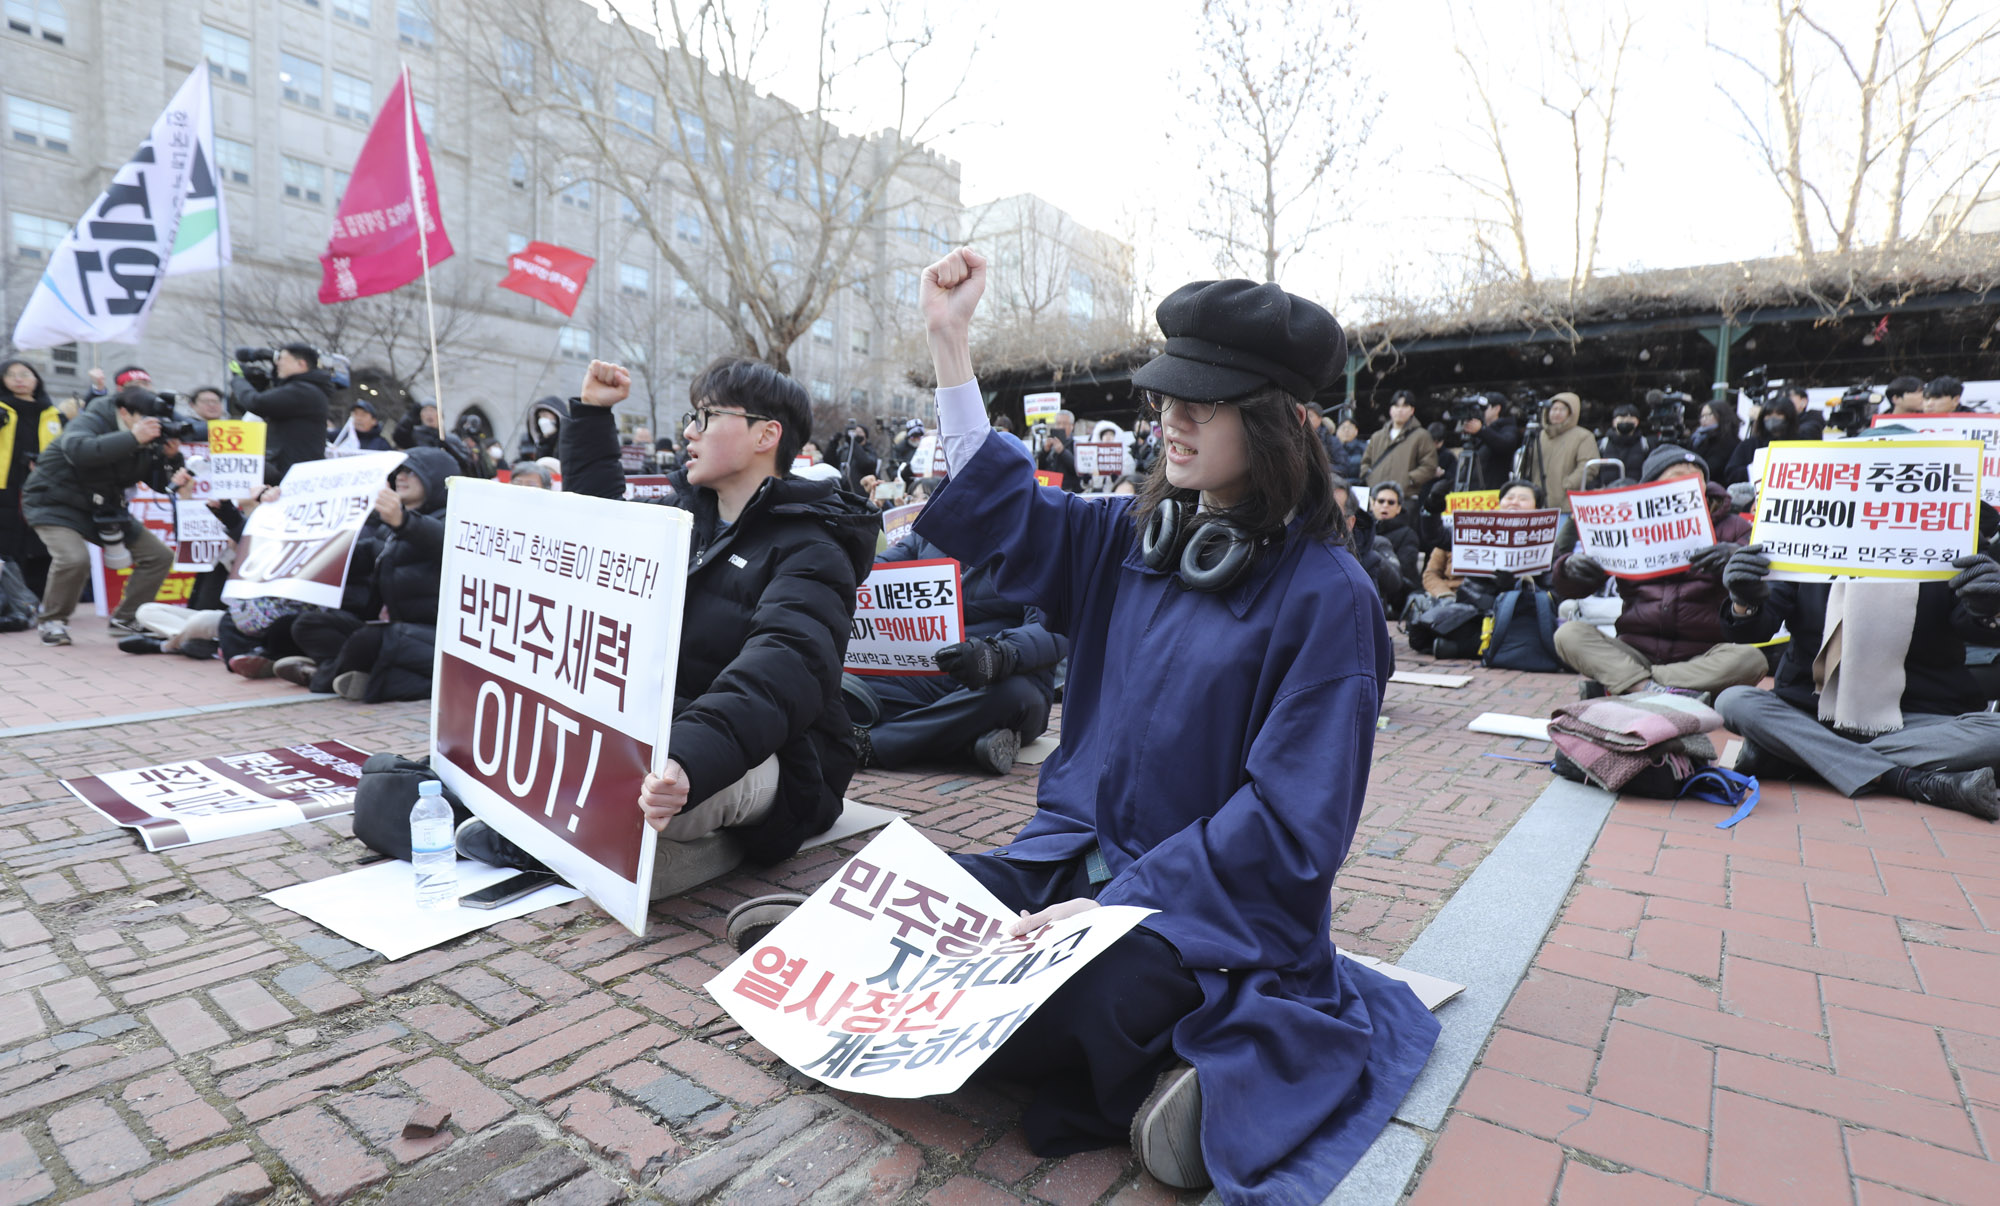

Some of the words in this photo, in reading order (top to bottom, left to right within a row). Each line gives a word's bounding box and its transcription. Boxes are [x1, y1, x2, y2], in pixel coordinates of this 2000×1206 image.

[1767, 462, 1861, 492] 내란세력
[1865, 463, 1975, 493] 추종하는
[1574, 502, 1635, 525] 계엄옹호
[1636, 489, 1703, 520] 내란동조
[1760, 497, 1857, 529] 고대생이
[1860, 500, 1973, 531] 부끄럽다
[1454, 528, 1509, 545] 내란수괴
[1513, 527, 1555, 545] 윤석열
[1587, 528, 1630, 549] 고대가
[1631, 516, 1702, 546] 막아내자
[455, 520, 526, 564] 고려대학교
[530, 534, 595, 583] 학생들이
[596, 549, 660, 599] 말한다!
[1463, 548, 1498, 567] 즉각
[1504, 548, 1547, 567] 파면!
[1761, 540, 1848, 561] 고려대학교
[1858, 545, 1960, 565] 민주동우회
[874, 579, 955, 610] 내란동조
[457, 573, 633, 714] 반민주세력
[873, 615, 948, 642] 막아내자
[472, 680, 603, 834] OUT!
[732, 945, 968, 1034] 열사정신
[800, 1001, 1035, 1080] 계승하자
